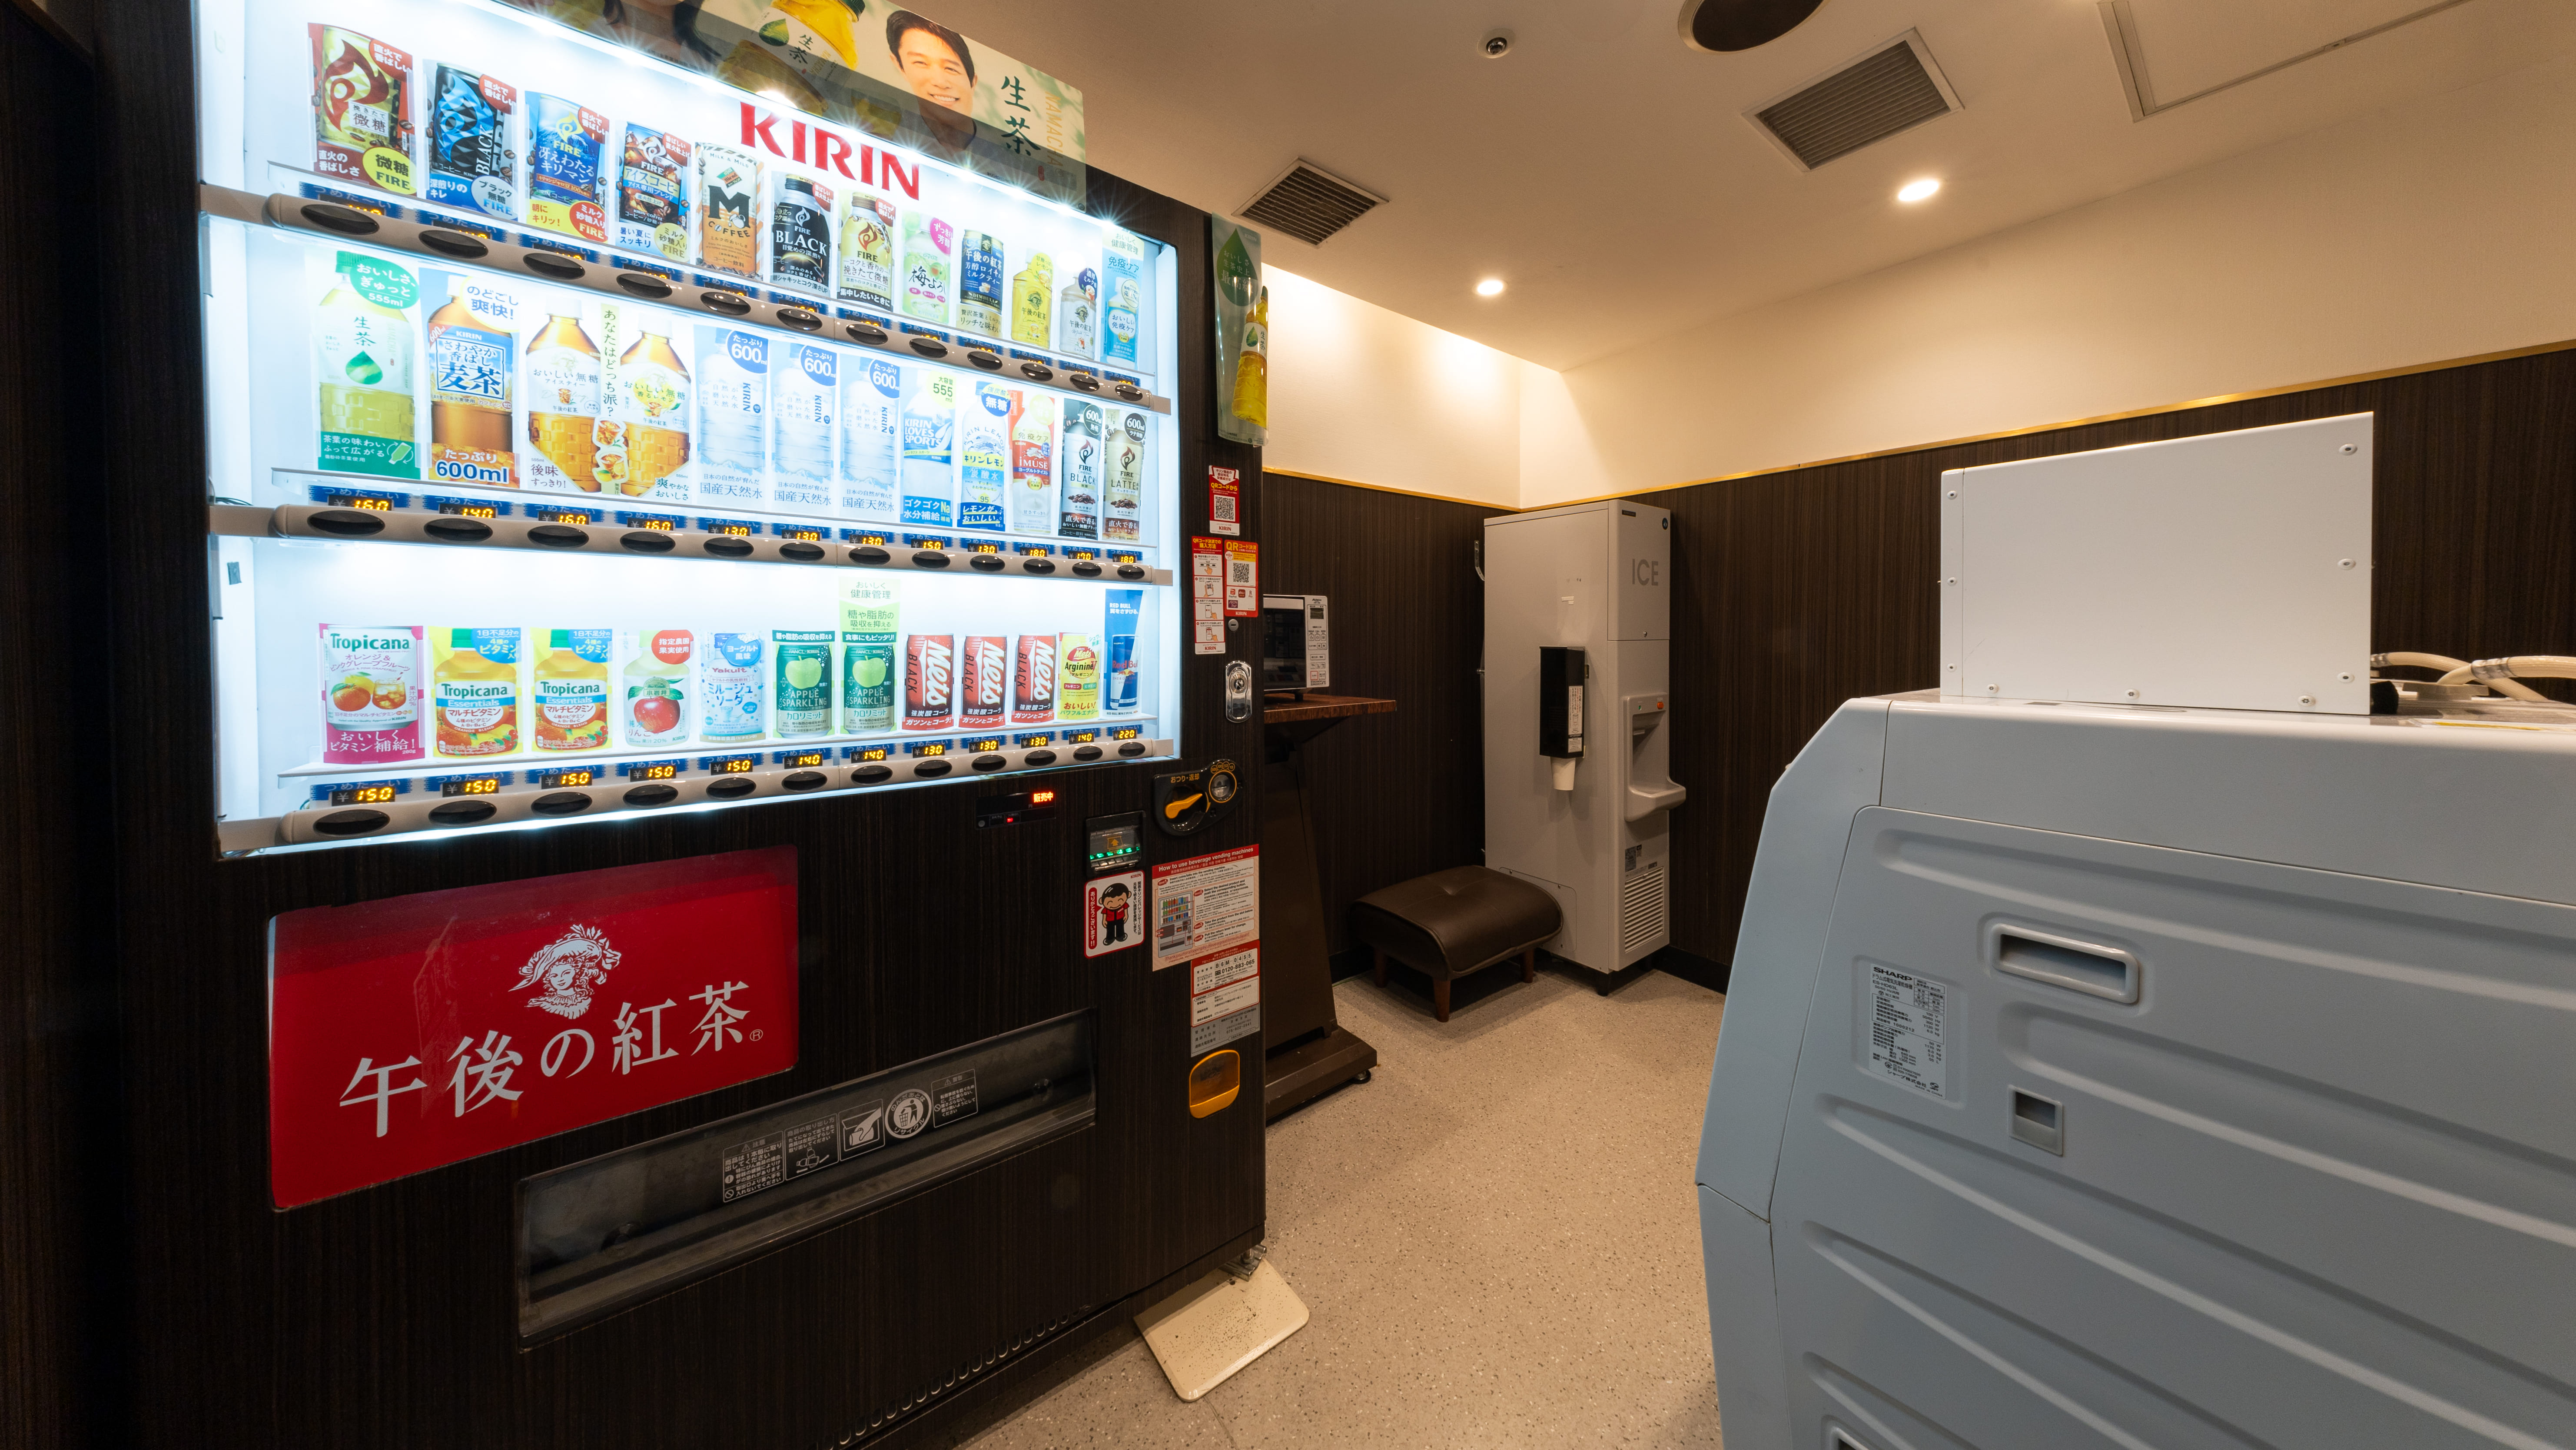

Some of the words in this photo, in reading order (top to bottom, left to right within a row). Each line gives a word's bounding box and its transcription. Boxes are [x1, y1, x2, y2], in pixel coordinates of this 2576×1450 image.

[789, 34, 813, 64] 生茶
[1001, 76, 1041, 156] 生茶
[1045, 91, 1063, 167] NAMACHA
[740, 101, 920, 201] KIRIN
[541, 161, 590, 183] キリマン
[625, 167, 679, 194] アイスコーヒー
[532, 203, 548, 213] 朝に
[620, 226, 651, 239] 暑い夏に
[620, 236, 651, 248] スッキリ
[776, 230, 828, 256] BLACK
[662, 244, 685, 258] FIRE
[857, 250, 878, 263] FIRE
[1223, 249, 1249, 266] おいしさ
[1109, 256, 1139, 273] 免疫ケア
[1223, 259, 1250, 276] 生茶史上
[360, 276, 411, 297] ぎゅっと
[1221, 269, 1254, 295] 最高級
[368, 293, 403, 307] 555ml
[467, 286, 519, 306] のどごし
[456, 330, 482, 341] KIRIN
[444, 340, 496, 357] さわやか
[449, 353, 491, 366] 香ばし
[439, 362, 502, 395] 麦茶
[986, 396, 1007, 412] 無糖
[905, 418, 932, 429] KIRIN
[905, 426, 934, 439] LOVES
[323, 435, 386, 447] 茶葉の味わい
[324, 445, 385, 457] ふって広がる
[445, 448, 498, 463] たっぷり
[436, 461, 509, 483] 600ml
[531, 464, 558, 477] 後味
[700, 482, 762, 499] 国産天然水
[1111, 480, 1137, 490] LATTE
[1211, 482, 1238, 491] QRコードから
[655, 489, 689, 501] おいしさ
[774, 490, 831, 506] 国産天然水
[843, 496, 894, 512] 国産天然水
[905, 499, 940, 509] ゴクゴク
[904, 510, 940, 521] 水分補給
[1226, 542, 1238, 551] QR
[1632, 559, 1658, 586] ICE
[856, 581, 886, 589] おいしく
[850, 589, 891, 599] 健康管理
[847, 609, 894, 620] 糖や脂肪の
[330, 633, 412, 652] Tropicana
[726, 644, 758, 653] ヨーグルト
[659, 646, 690, 655] 果実使用
[1074, 649, 1091, 660] Mets
[907, 653, 917, 693] BLACK
[964, 654, 974, 692] BLACK
[1018, 652, 1027, 689] BLACK
[1033, 639, 1055, 702] Mets
[441, 683, 508, 699] Tropicana
[540, 682, 600, 696] Tropicana
[707, 682, 753, 695] ミルージュ
[790, 688, 819, 698] APPLE
[857, 688, 884, 697] APPLE
[448, 699, 500, 708] Essentials
[715, 693, 743, 706] ソーダ
[782, 697, 827, 708] SPARKLING
[849, 696, 890, 705] SPARKLING
[446, 708, 501, 717] マルチビタミン
[545, 705, 594, 713] マルチビタミン
[786, 711, 823, 720] カロリミット
[911, 708, 949, 717] 強炭酸コーラ
[341, 730, 398, 741] おいしく
[628, 728, 651, 737] りんご
[1078, 733, 1092, 742] 140
[1119, 730, 1135, 738] 220
[979, 741, 996, 750] 130
[1030, 737, 1046, 746] 130
[863, 750, 884, 760] 140
[923, 745, 943, 755] 130
[727, 760, 749, 772] 150
[798, 754, 820, 765] 140
[561, 772, 589, 785] 150
[648, 766, 673, 778] 150
[1171, 773, 1199, 783] おつり・返却
[1033, 792, 1053, 803] 販売中
[1188, 857, 1211, 866] beverage
[1222, 959, 1255, 974] 0120-883-065
[1873, 967, 1912, 981] SHARP
[1873, 980, 1898, 991] ES-HD63L
[1893, 1022, 1915, 1032] 1000212
[339, 980, 751, 1139] 午後の紅茶
[1887, 1070, 1926, 1088] シャープ株式会社
[891, 1092, 926, 1111] のんだあとは
[787, 1117, 835, 1137] 商品の取り出し方
[894, 1117, 925, 1135] リサイクル
[788, 1124, 835, 1143] たてになって出てきた
[788, 1129, 835, 1148] 商品は左右にずらして
[752, 1139, 765, 1148] 注意
[788, 1136, 831, 1153] 取り出してください
[725, 1153, 770, 1172] 出してください
[736, 1177, 781, 1197] 入れないでください
